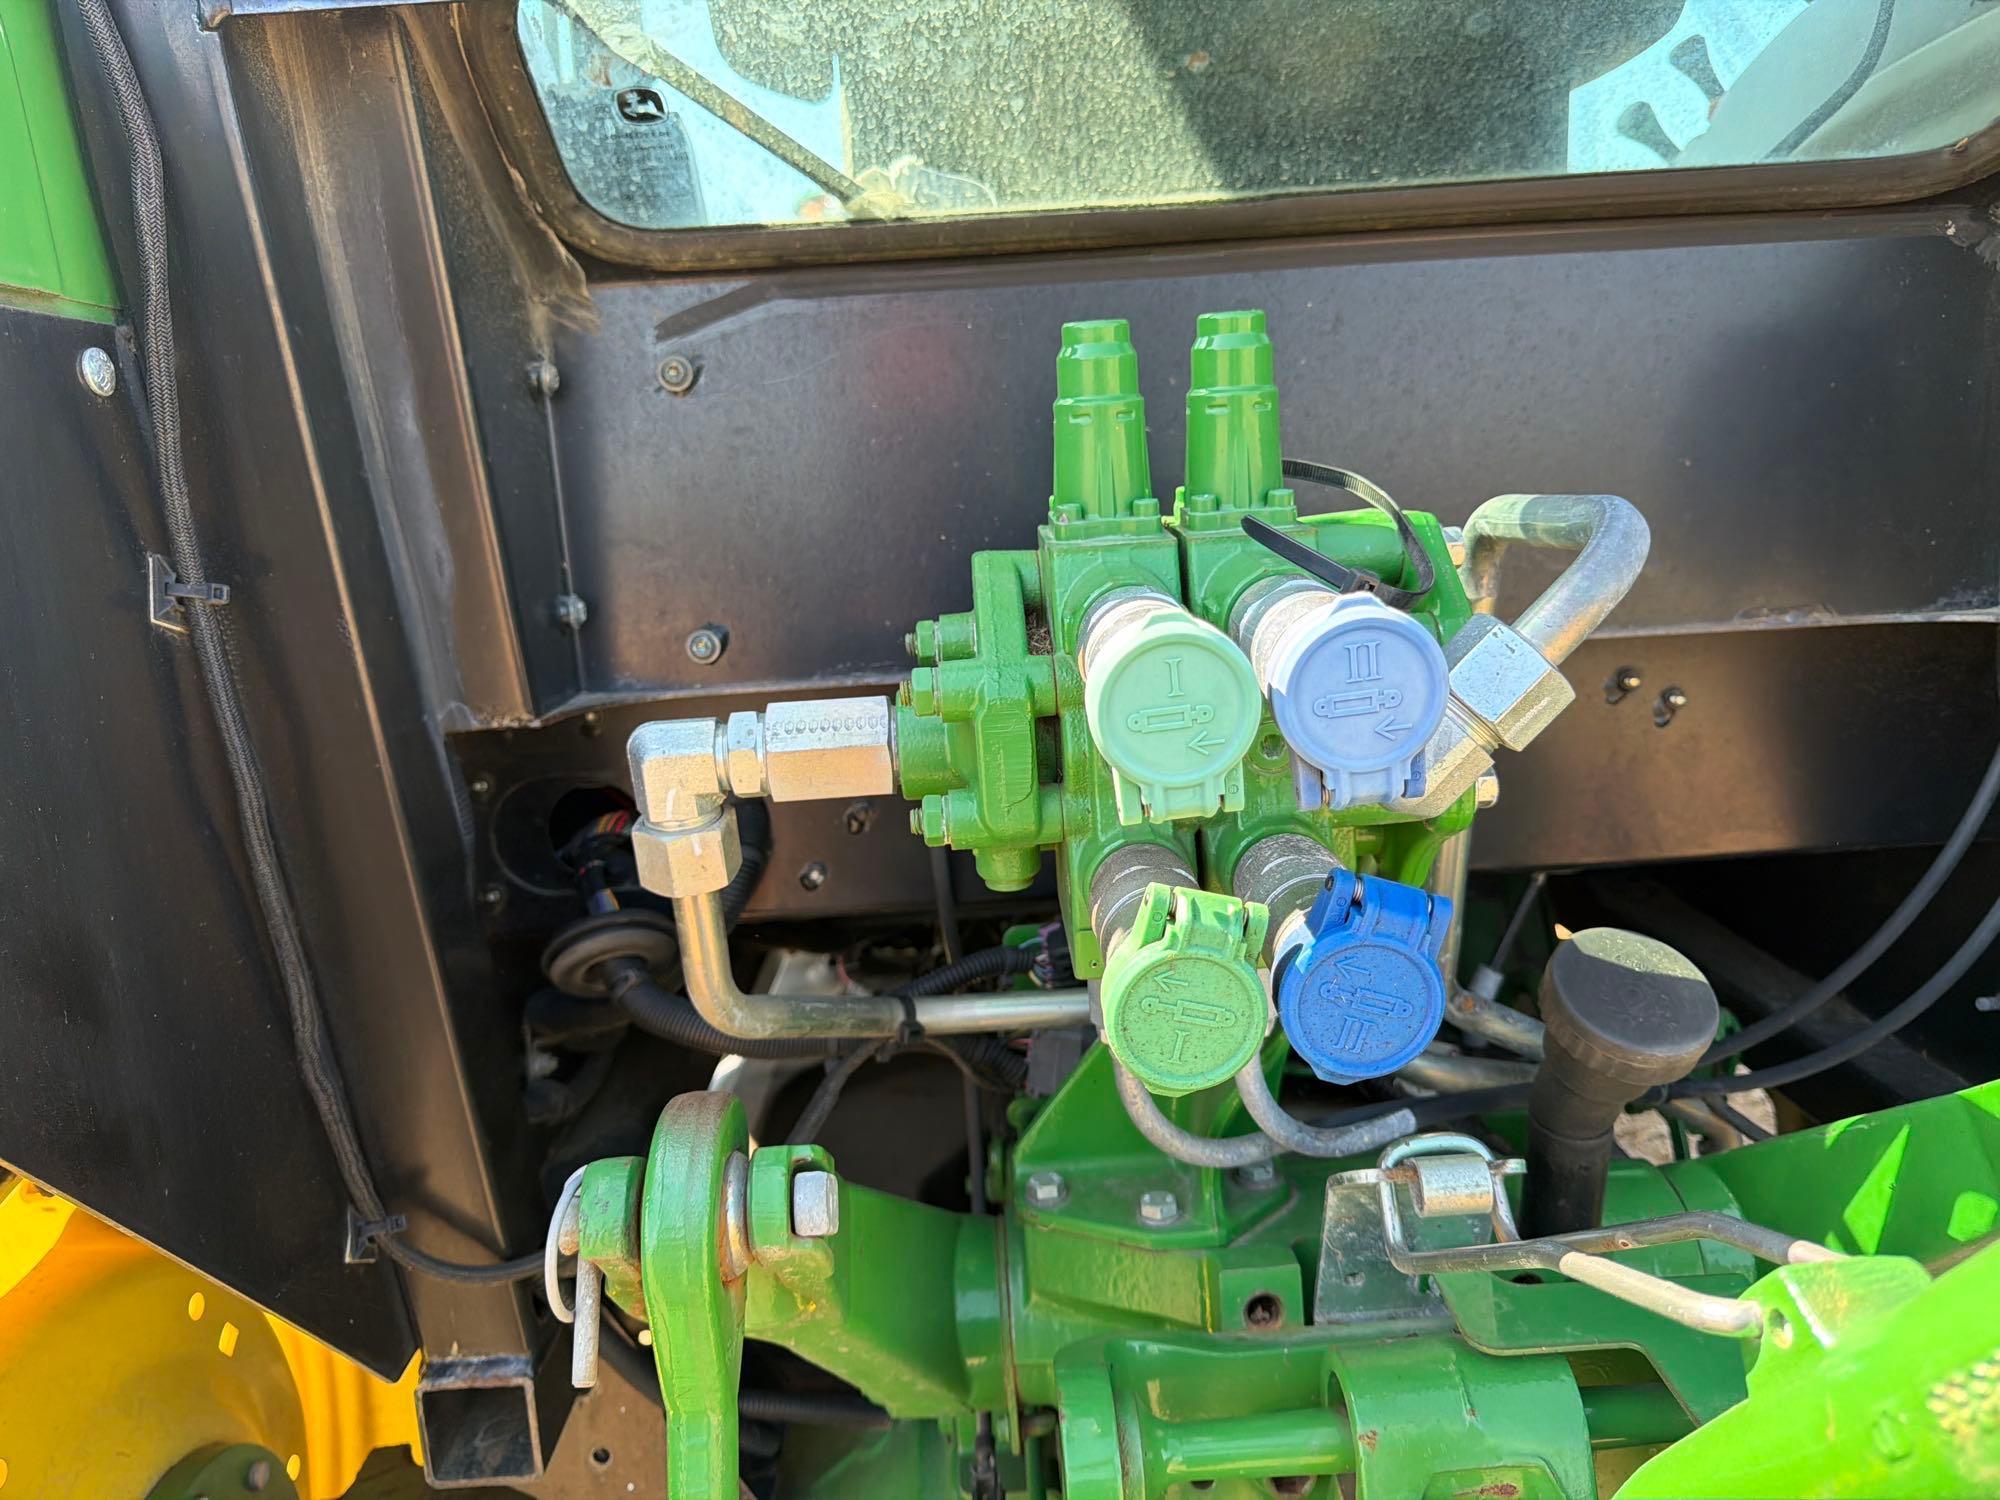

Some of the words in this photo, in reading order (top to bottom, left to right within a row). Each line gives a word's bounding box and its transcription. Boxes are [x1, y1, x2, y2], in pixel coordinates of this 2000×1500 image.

[1165, 657, 1184, 698] I
[1344, 641, 1382, 683] II
[1169, 1030, 1190, 1064] I
[1333, 1016, 1376, 1053] II
